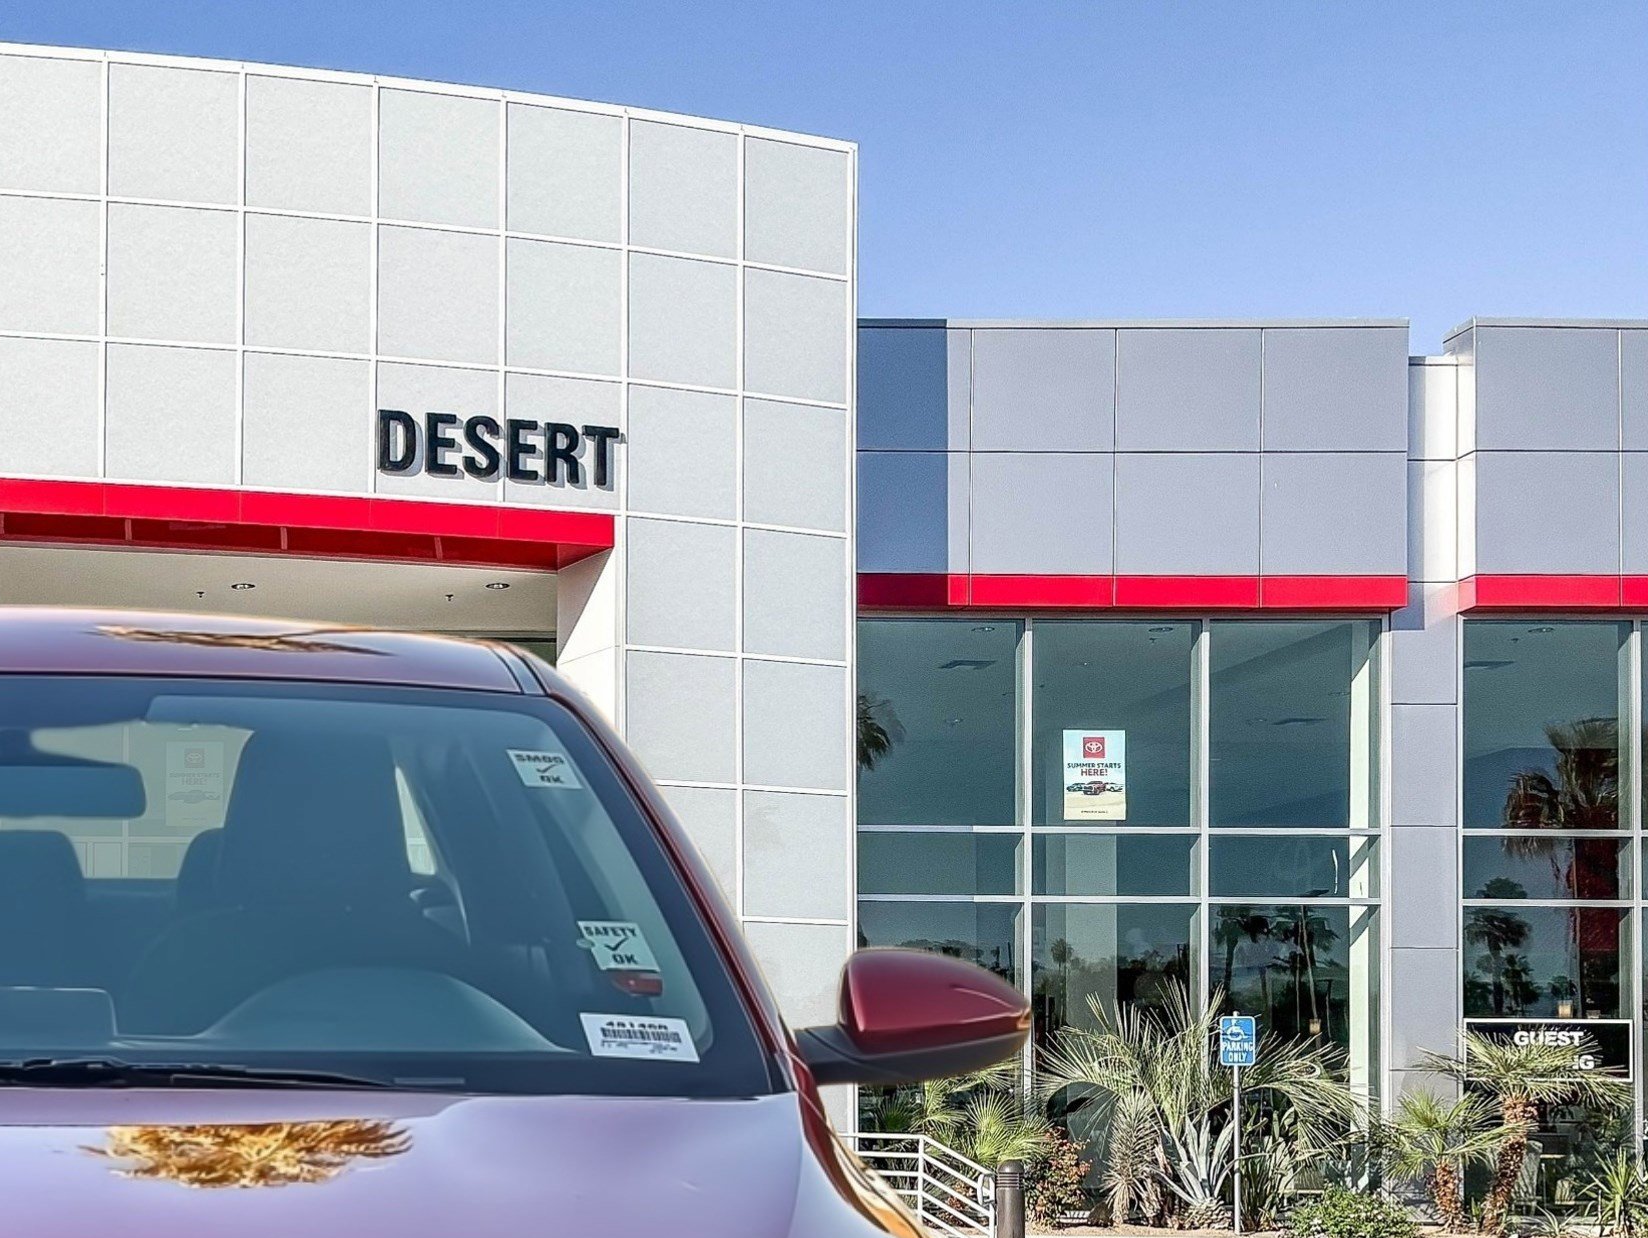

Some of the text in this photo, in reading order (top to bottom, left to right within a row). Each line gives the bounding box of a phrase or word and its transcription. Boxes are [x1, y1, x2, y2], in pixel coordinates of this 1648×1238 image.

[377, 409, 620, 486] DESERT
[1081, 769, 1108, 777] HERE!
[583, 926, 637, 937] SAFETY
[612, 954, 639, 965] OK
[1514, 1031, 1584, 1047] GUEST
[1222, 1041, 1253, 1052] PARKING
[1228, 1052, 1247, 1063] ONLY
